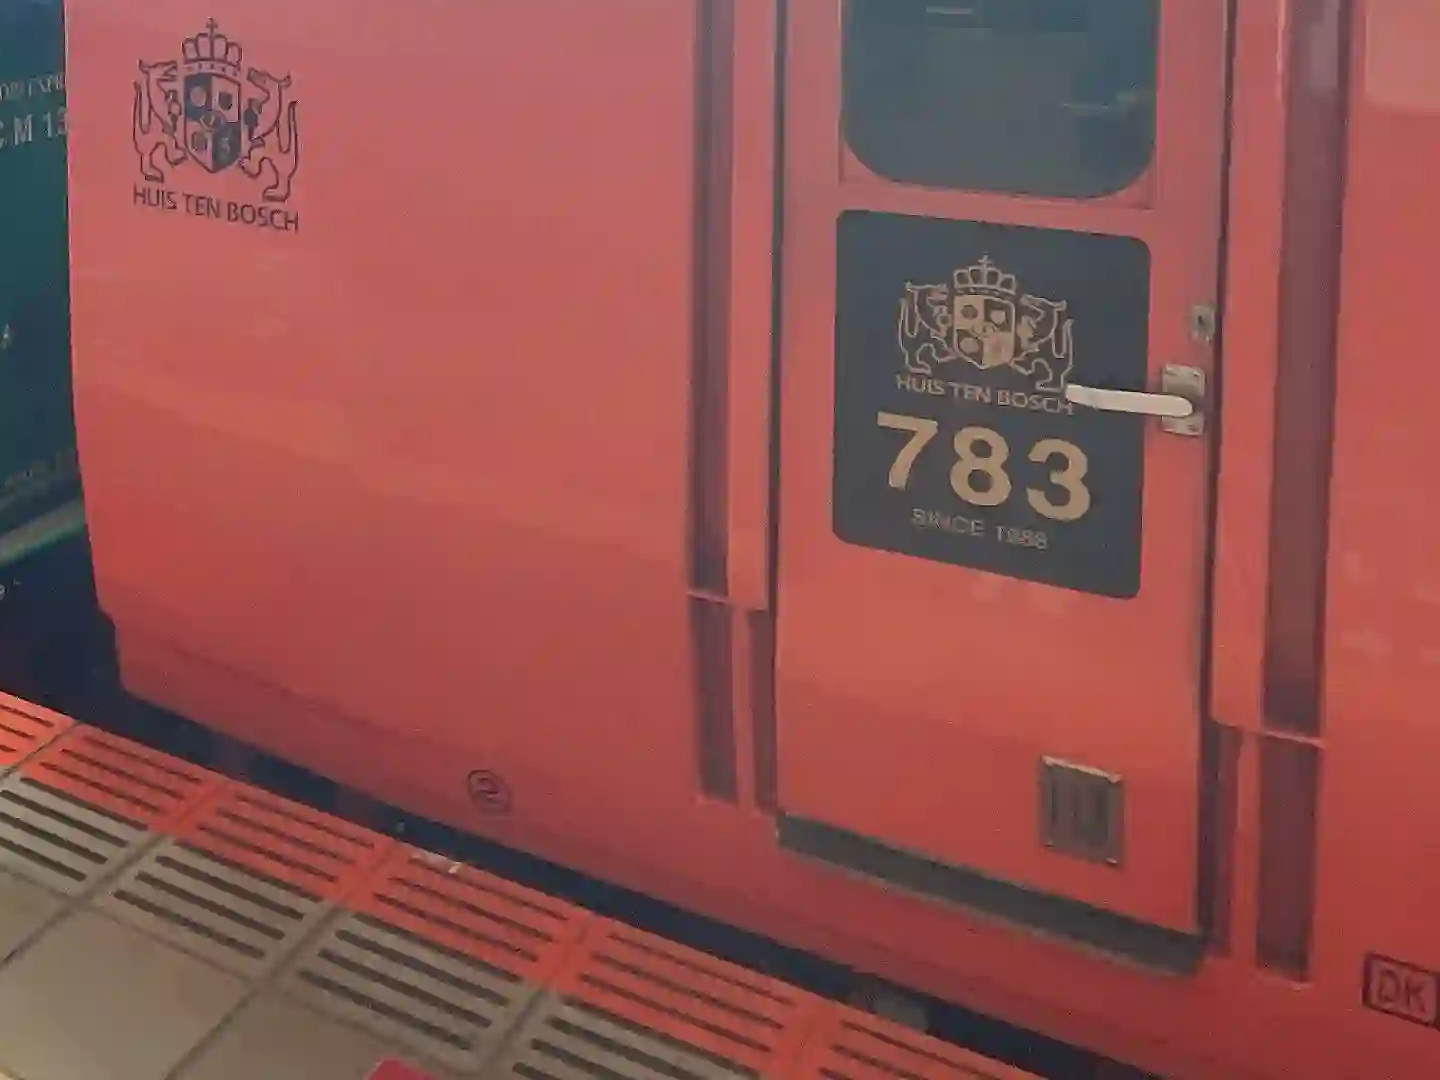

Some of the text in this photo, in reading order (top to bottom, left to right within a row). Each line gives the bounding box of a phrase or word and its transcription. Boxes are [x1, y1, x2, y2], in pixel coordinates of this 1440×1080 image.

[133, 183, 299, 234] HUIS TEN BOSCH
[896, 375, 1074, 415] HUIS TEN BOSCH
[877, 411, 1091, 522] 783
